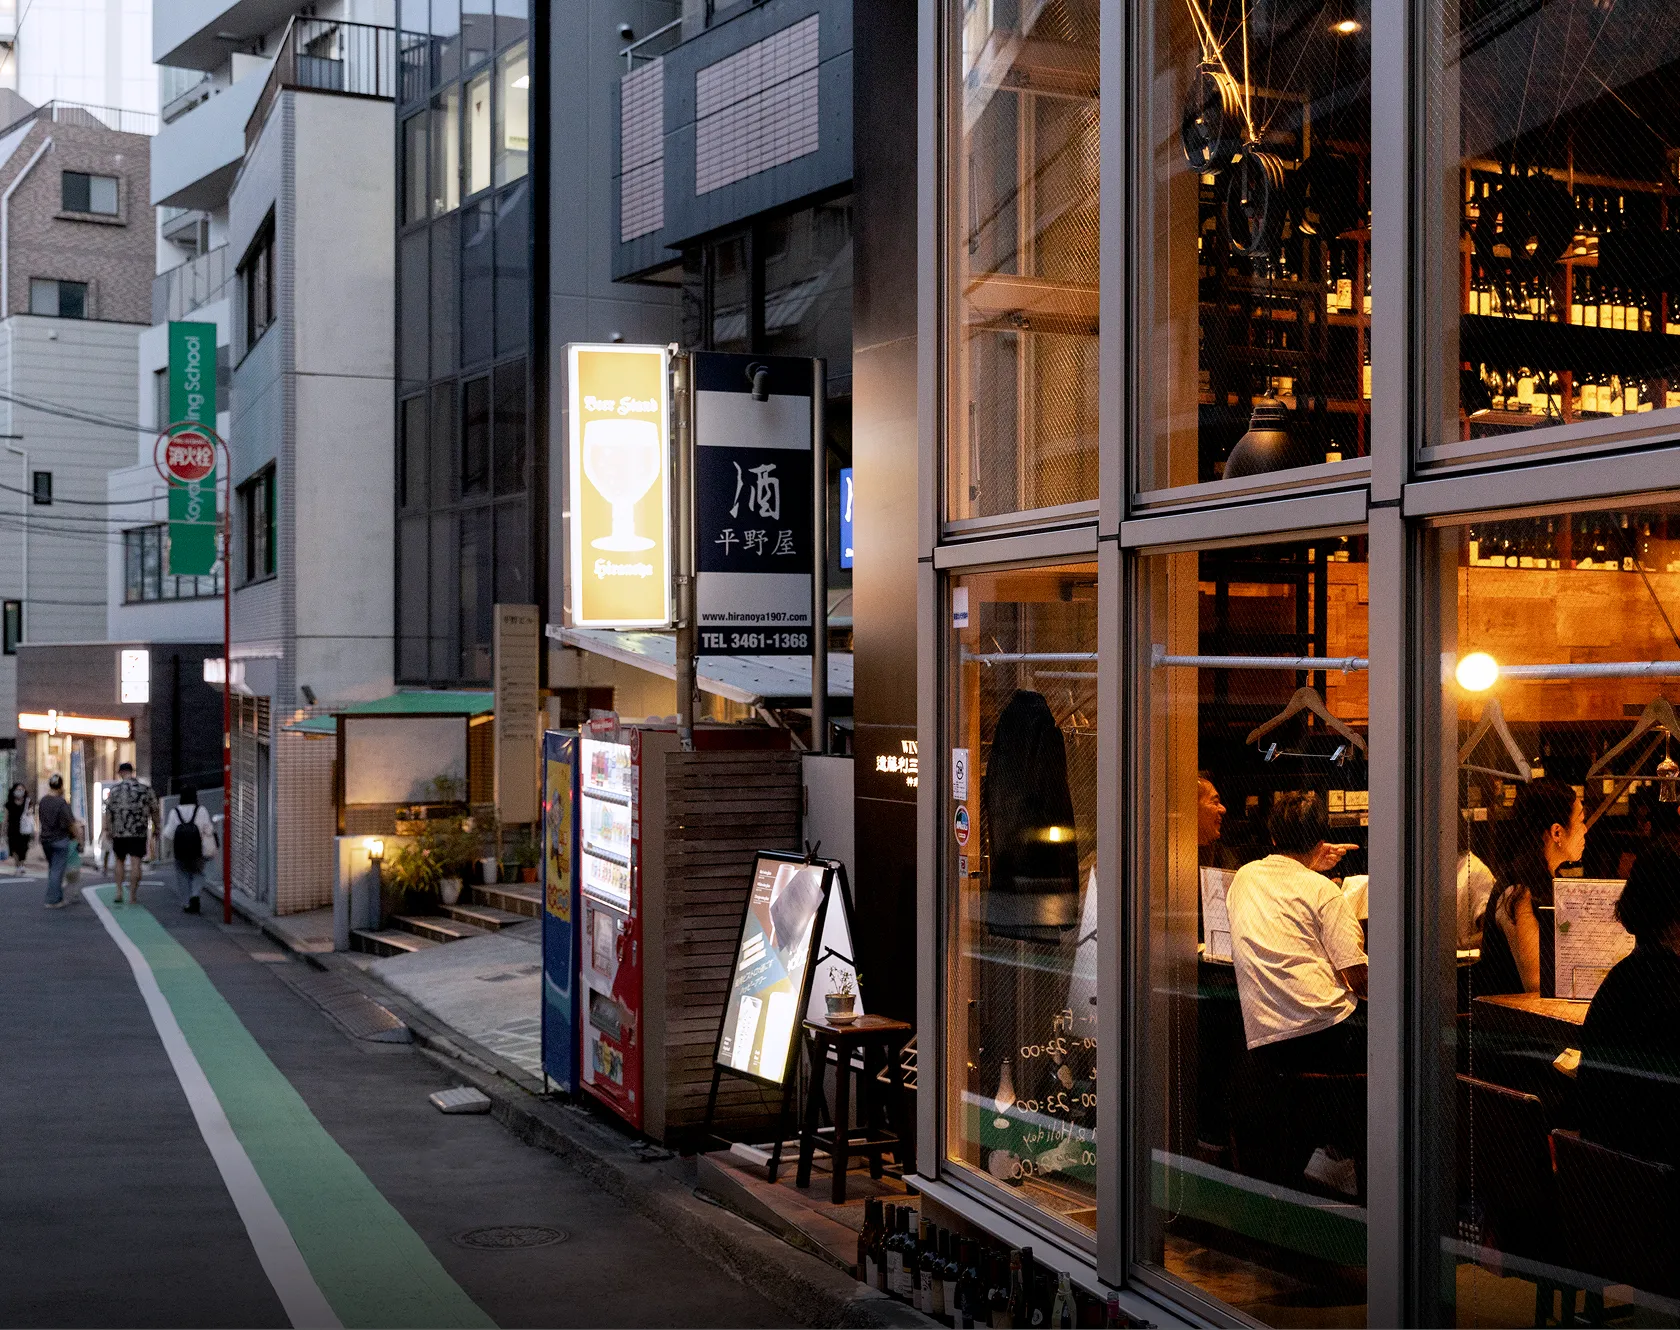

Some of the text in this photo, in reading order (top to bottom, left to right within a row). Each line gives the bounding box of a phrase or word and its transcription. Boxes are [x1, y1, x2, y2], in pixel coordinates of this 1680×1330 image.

[184, 335, 201, 391] School
[168, 445, 213, 467] 消火栓
[185, 482, 204, 523] Koya
[729, 460, 781, 521] 酒
[714, 528, 797, 556] 平野屋
[701, 611, 808, 623] www.hiranoya1907.com
[701, 632, 809, 649] TEL 3461-1368
